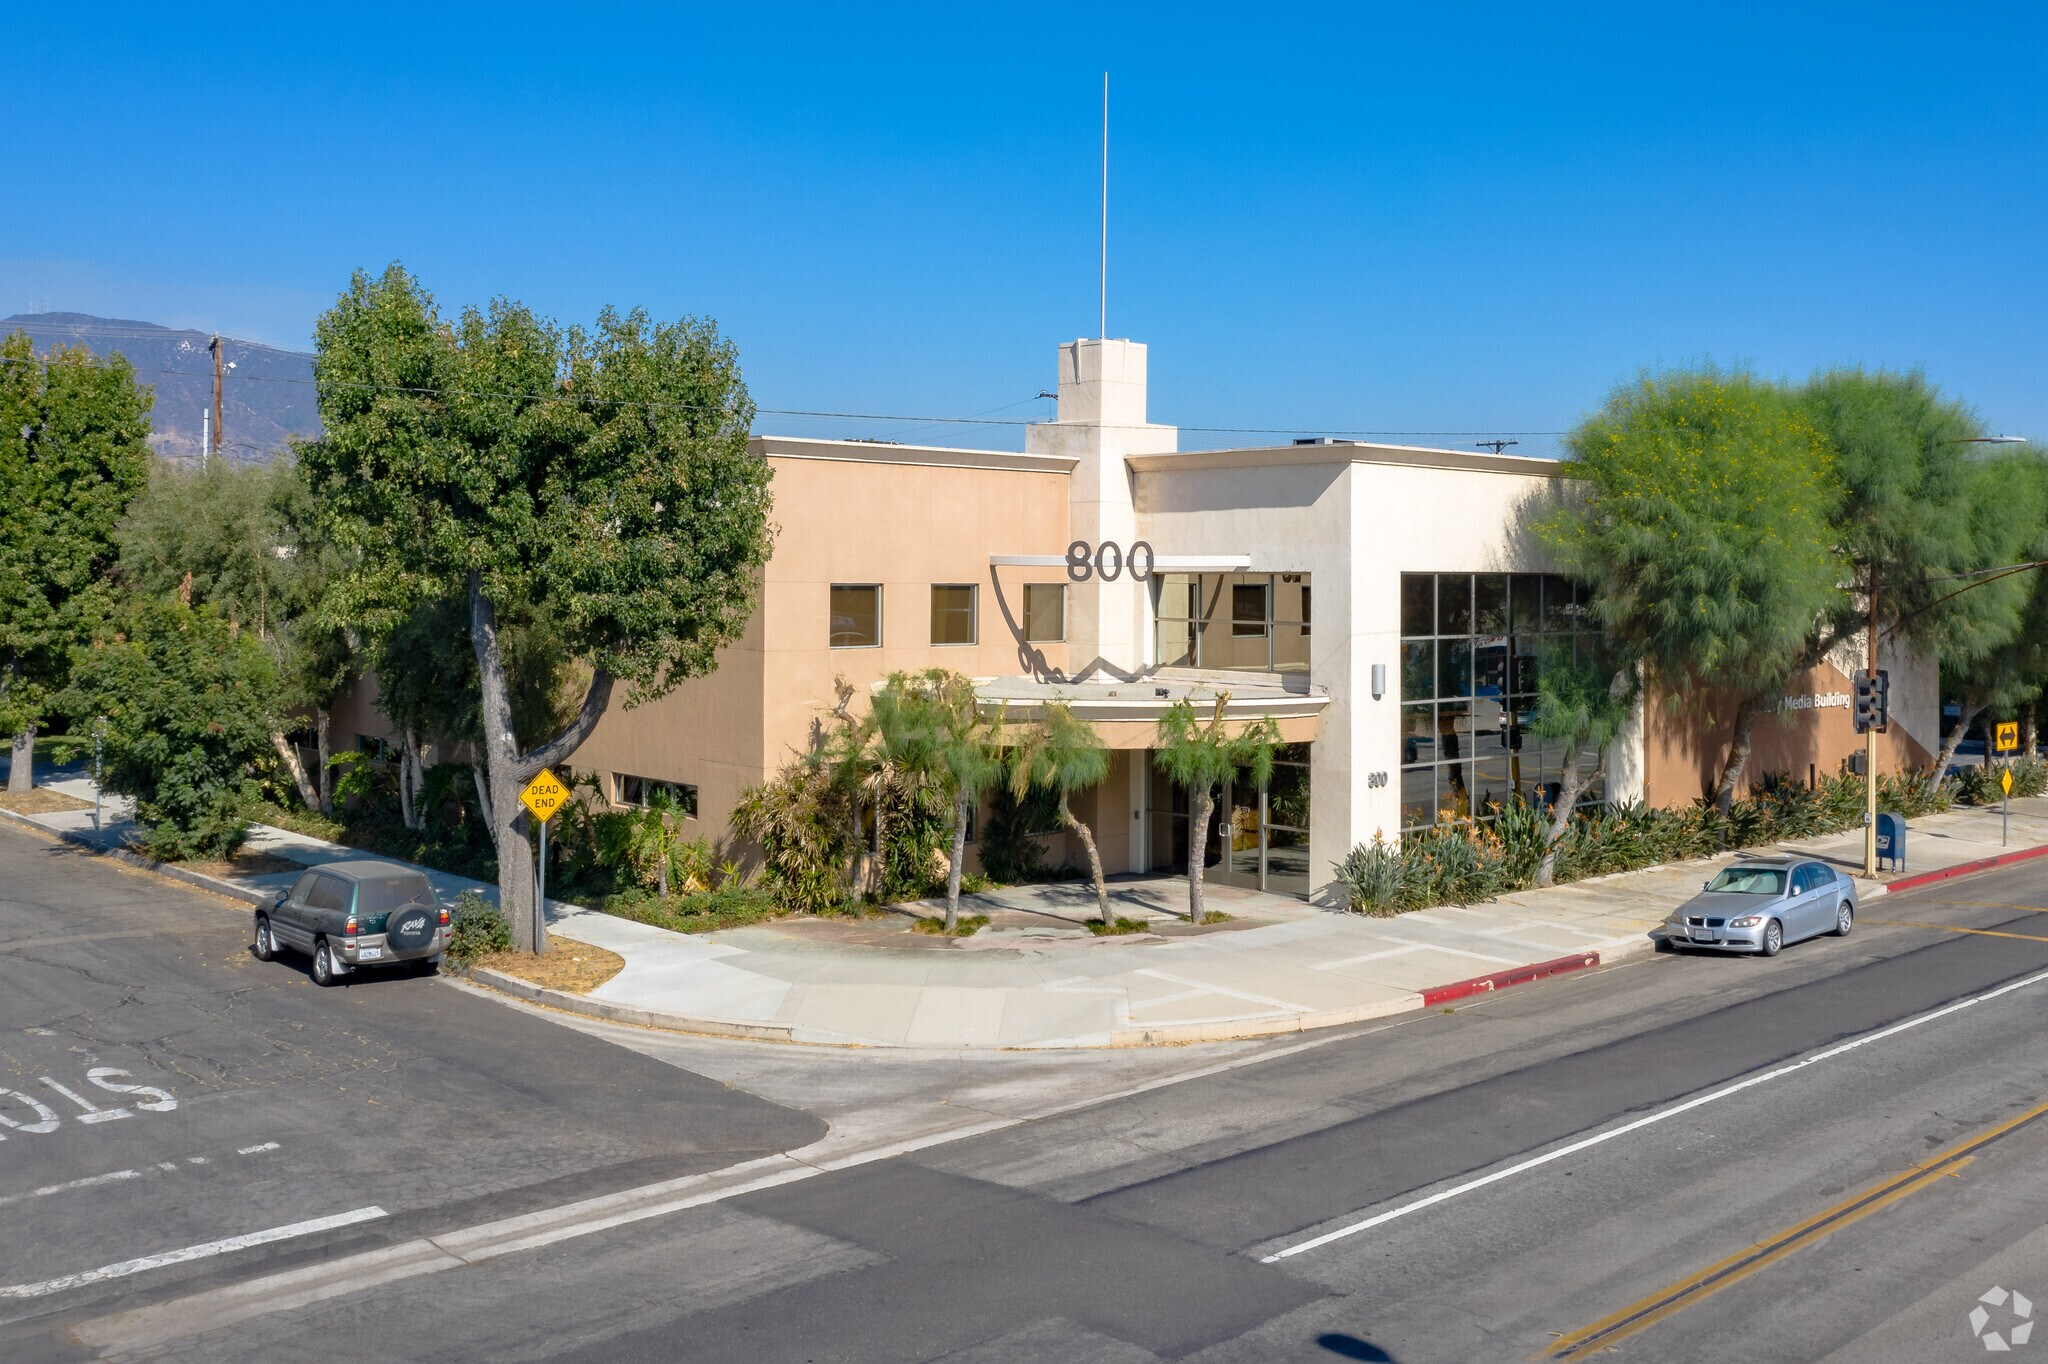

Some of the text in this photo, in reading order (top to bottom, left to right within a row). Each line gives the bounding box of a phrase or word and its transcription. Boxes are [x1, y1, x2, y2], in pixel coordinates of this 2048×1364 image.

[1065, 540, 1155, 582] 800
[1784, 694, 1812, 711] Media
[1814, 691, 1850, 709] Building
[532, 785, 559, 795] DEAD
[535, 798, 555, 808] END
[0, 1067, 178, 1141] STO
